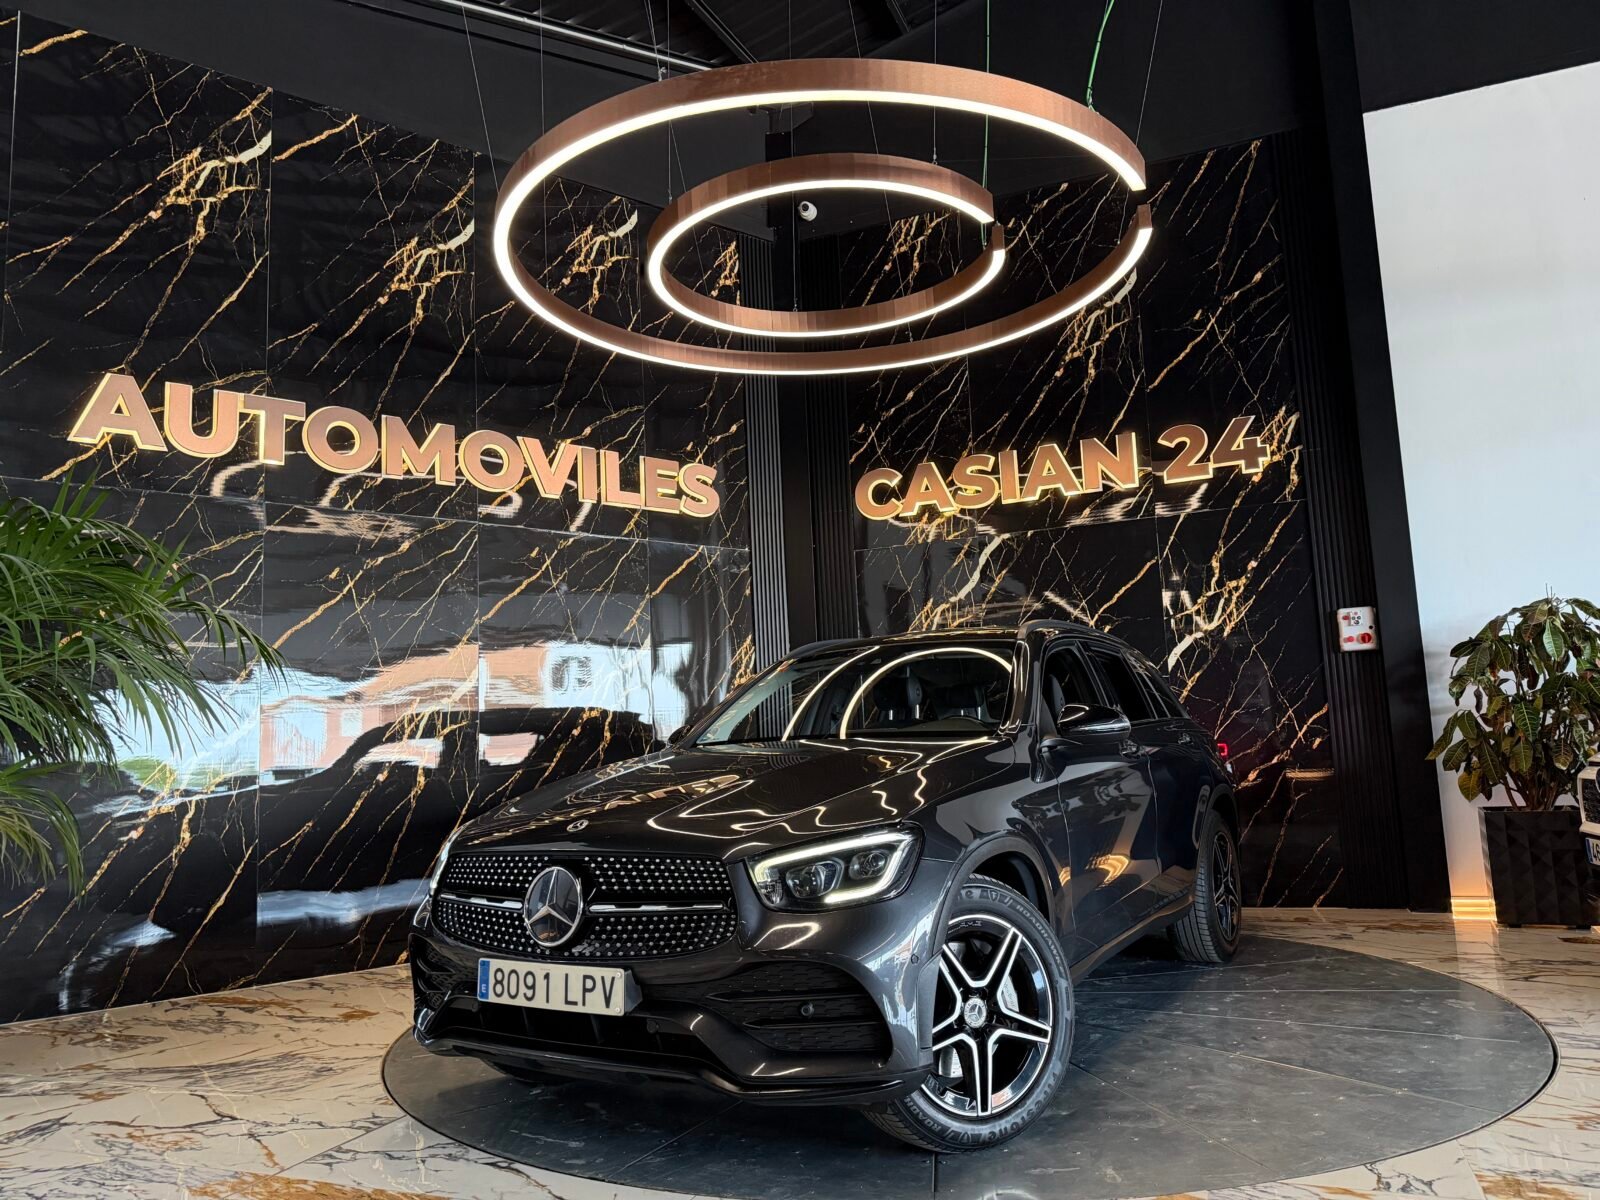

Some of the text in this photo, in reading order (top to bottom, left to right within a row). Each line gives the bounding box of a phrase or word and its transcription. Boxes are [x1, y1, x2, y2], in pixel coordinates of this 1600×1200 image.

[67, 372, 721, 518] AUTOMOVILES
[854, 415, 1271, 521] CASIAN 24
[481, 983, 487, 993] E
[492, 967, 616, 1009] 8091 LPV
[903, 1096, 942, 1132] ROADH
